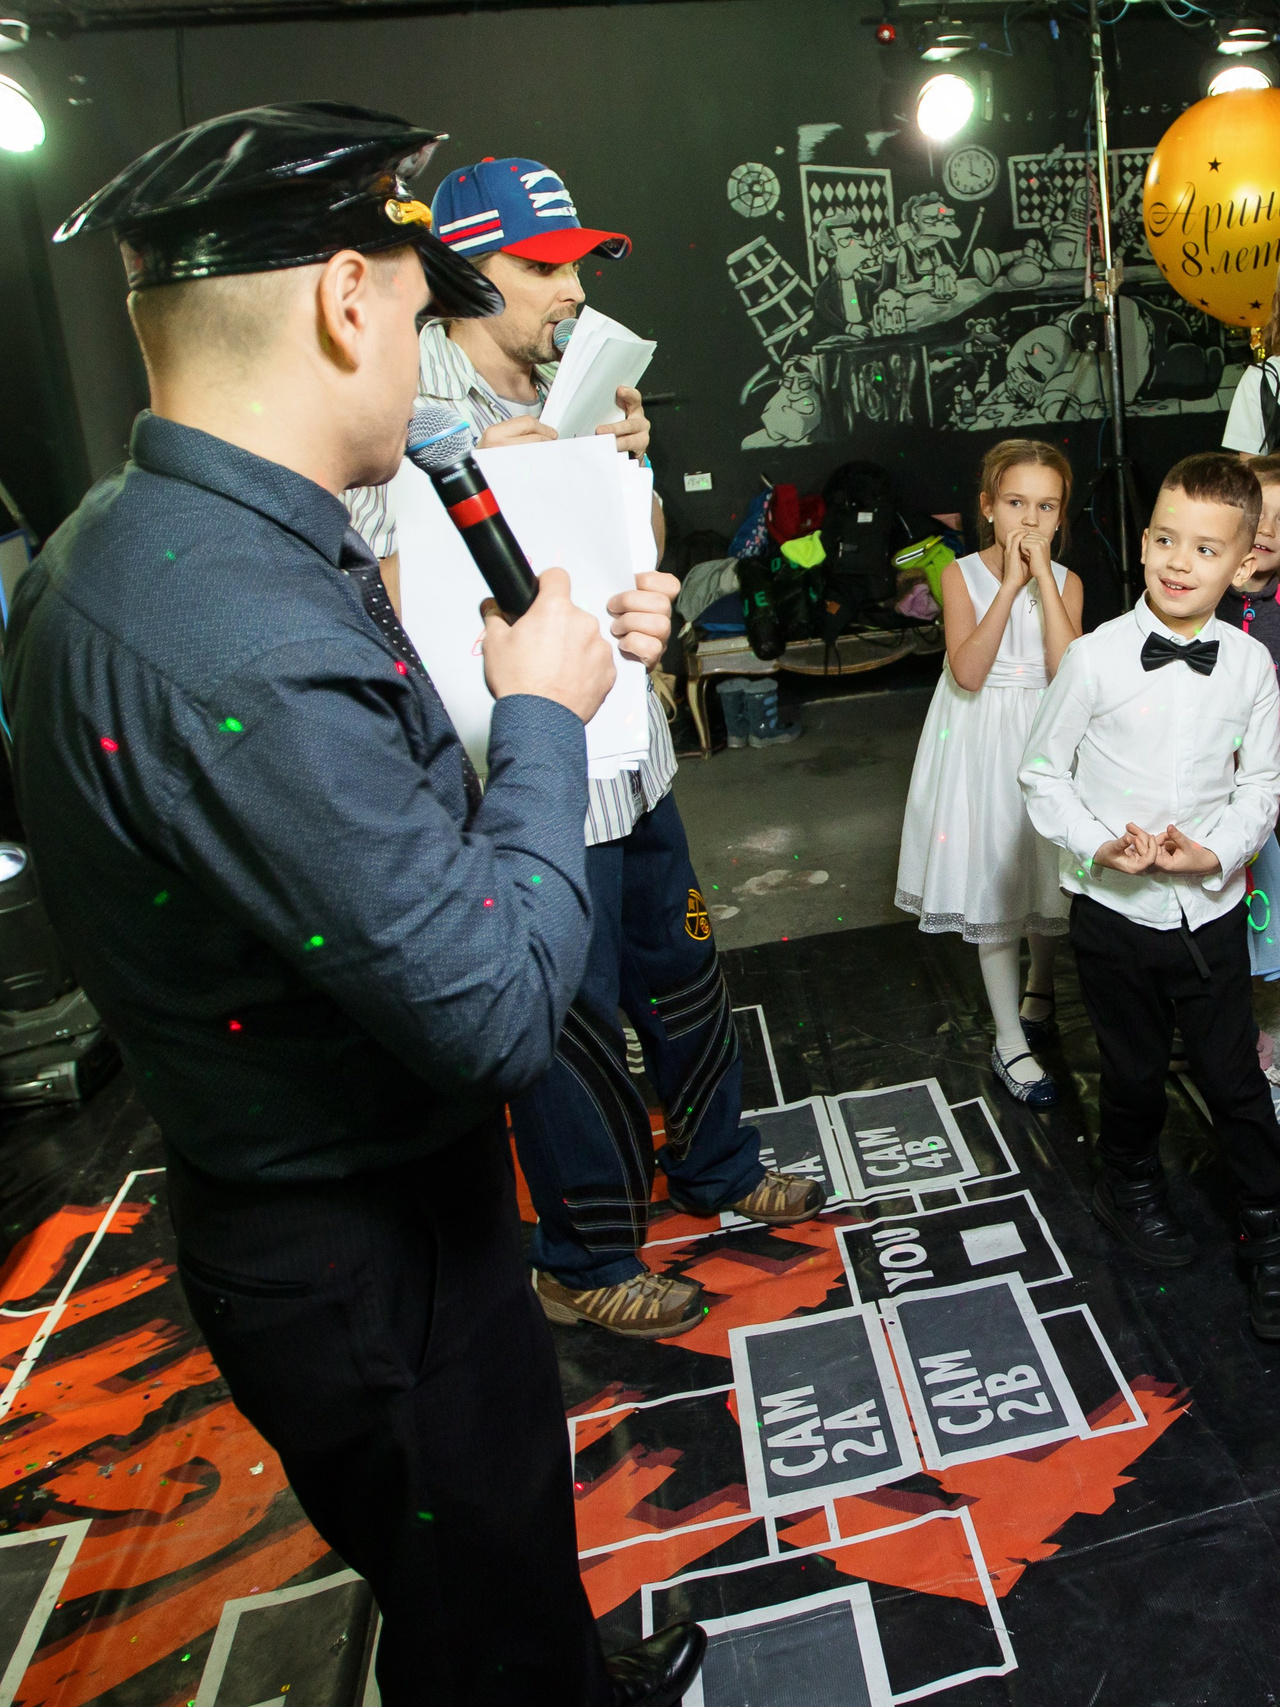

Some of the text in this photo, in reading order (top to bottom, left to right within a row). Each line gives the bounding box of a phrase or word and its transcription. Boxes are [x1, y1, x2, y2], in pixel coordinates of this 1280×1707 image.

[855, 1126, 910, 1177] CAM
[904, 1135, 952, 1169] 4B
[872, 1227, 934, 1293] YOU
[918, 1349, 995, 1435] CAM
[984, 1364, 1053, 1422] 2B
[760, 1385, 829, 1477] CAM
[823, 1398, 888, 1464] 2A
